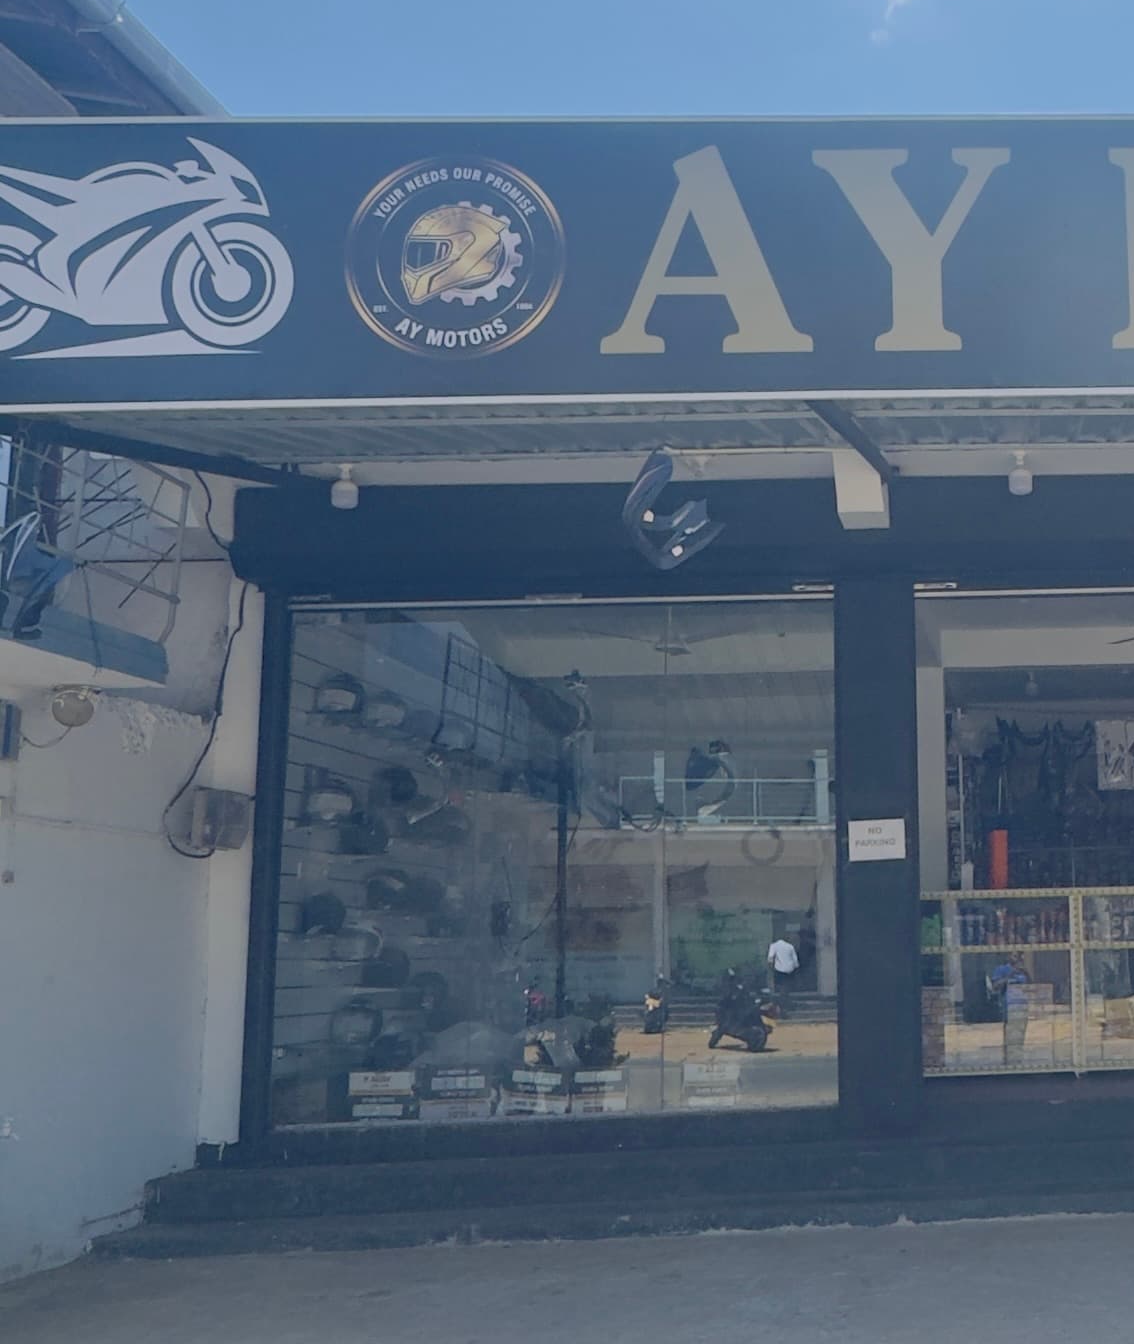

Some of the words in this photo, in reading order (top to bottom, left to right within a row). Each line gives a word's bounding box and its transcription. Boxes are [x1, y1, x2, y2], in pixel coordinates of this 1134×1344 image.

[373, 188, 405, 219] YOUR
[405, 168, 449, 193] NEEDS
[453, 167, 481, 180] OUR
[484, 173, 536, 216] PROMISE
[600, 144, 1011, 354] AY
[395, 318, 423, 339] AY
[426, 318, 508, 348] MOTORS
